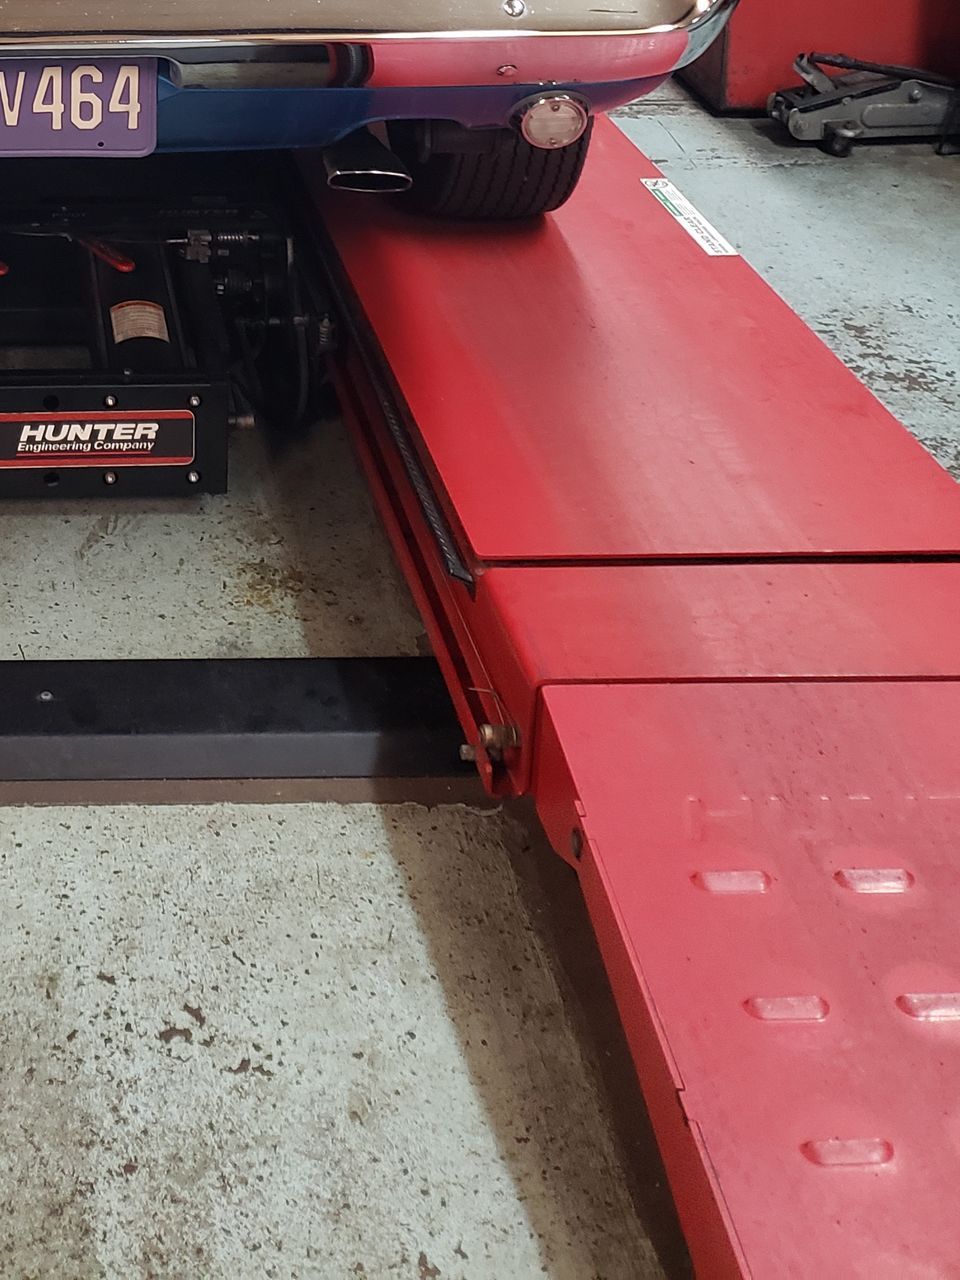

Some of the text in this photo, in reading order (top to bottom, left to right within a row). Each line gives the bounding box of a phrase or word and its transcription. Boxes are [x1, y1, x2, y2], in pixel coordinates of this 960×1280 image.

[19, 423, 159, 441] HUNTER
[17, 440, 155, 453] Engineering Company
